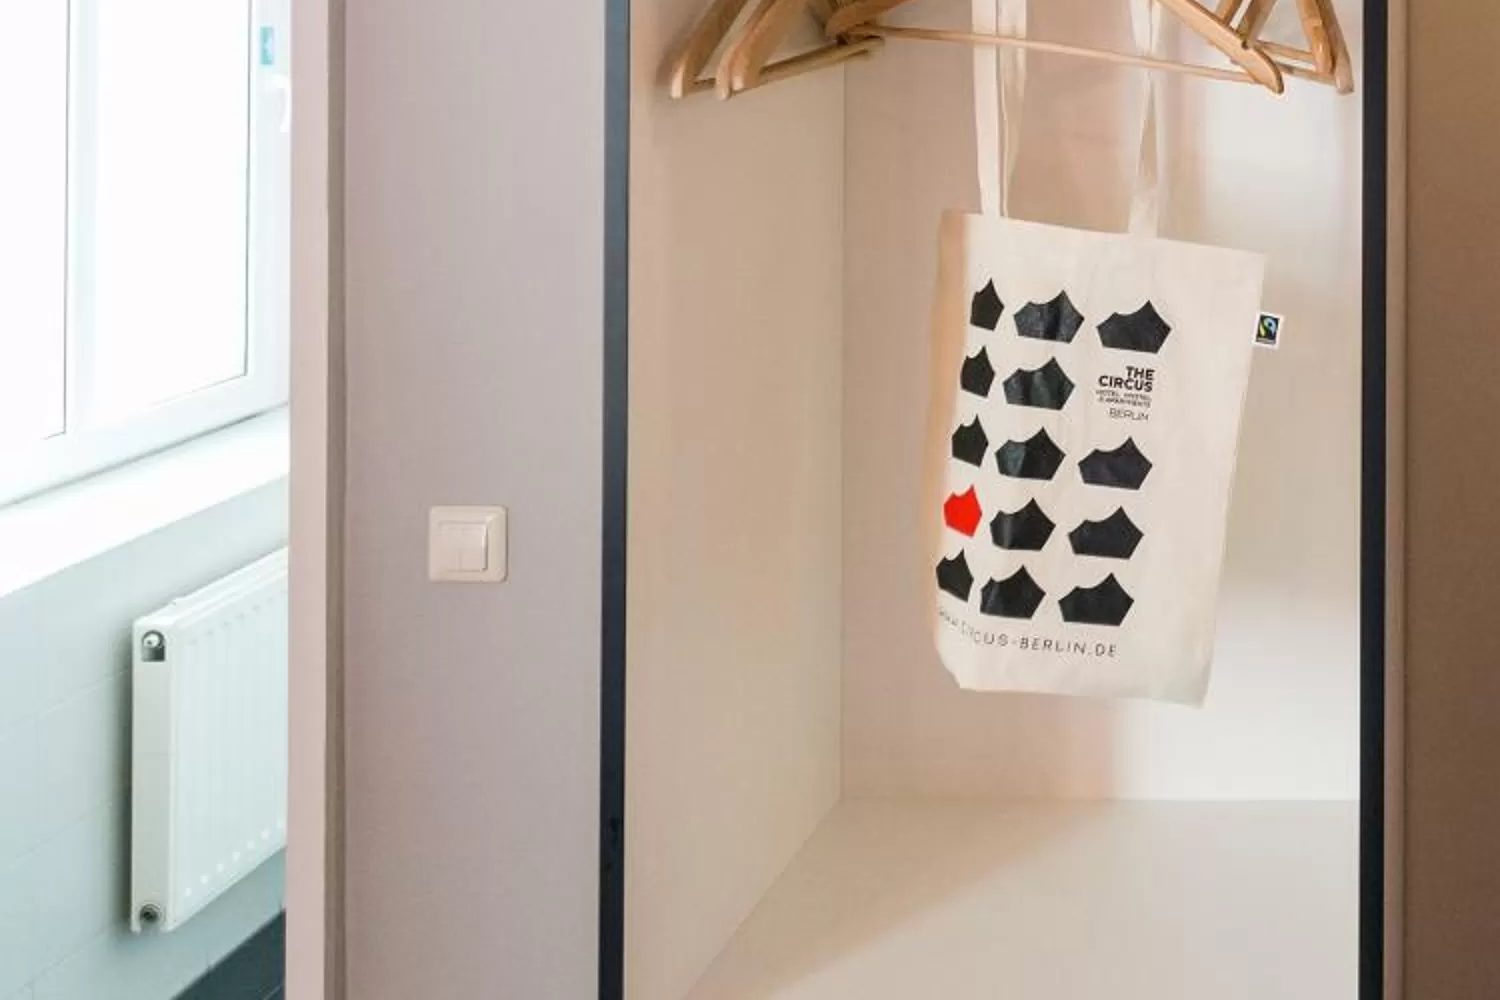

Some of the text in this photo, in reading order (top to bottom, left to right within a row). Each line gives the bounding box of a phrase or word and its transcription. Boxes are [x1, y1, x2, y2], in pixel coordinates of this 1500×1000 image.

[1126, 366, 1156, 381] THE
[1098, 375, 1153, 393] CIRCUS
[1109, 407, 1149, 421] BERLIN
